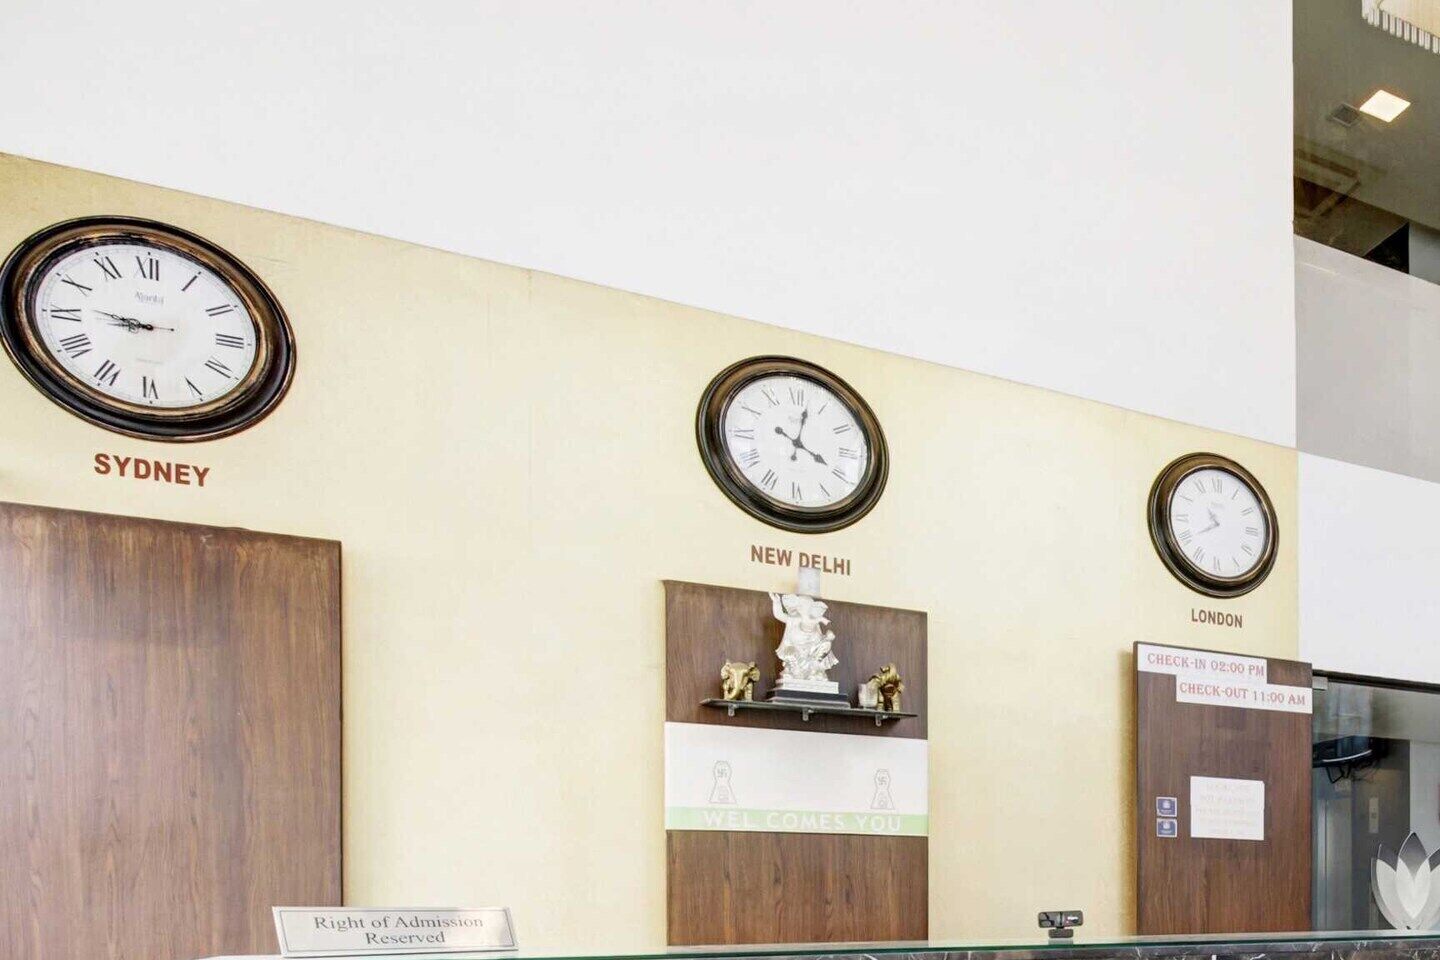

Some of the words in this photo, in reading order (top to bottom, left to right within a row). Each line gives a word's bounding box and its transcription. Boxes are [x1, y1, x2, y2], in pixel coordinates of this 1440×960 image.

[94, 453, 210, 488] SYDNEY
[751, 544, 792, 567] NEW
[799, 551, 851, 576] DELHI
[1191, 607, 1243, 629] LONDON
[1147, 653, 1207, 670] CHECK-IN
[1211, 660, 1245, 674] 02:00
[1249, 666, 1265, 677] PM
[1179, 682, 1248, 699] CHECK-OUT
[1253, 690, 1284, 703] 11:00
[1288, 694, 1306, 706] AM
[856, 816, 901, 832] YOU
[314, 915, 365, 931] Right
[372, 915, 390, 929] of
[394, 915, 484, 929] Admission
[365, 931, 445, 945] Reserved
